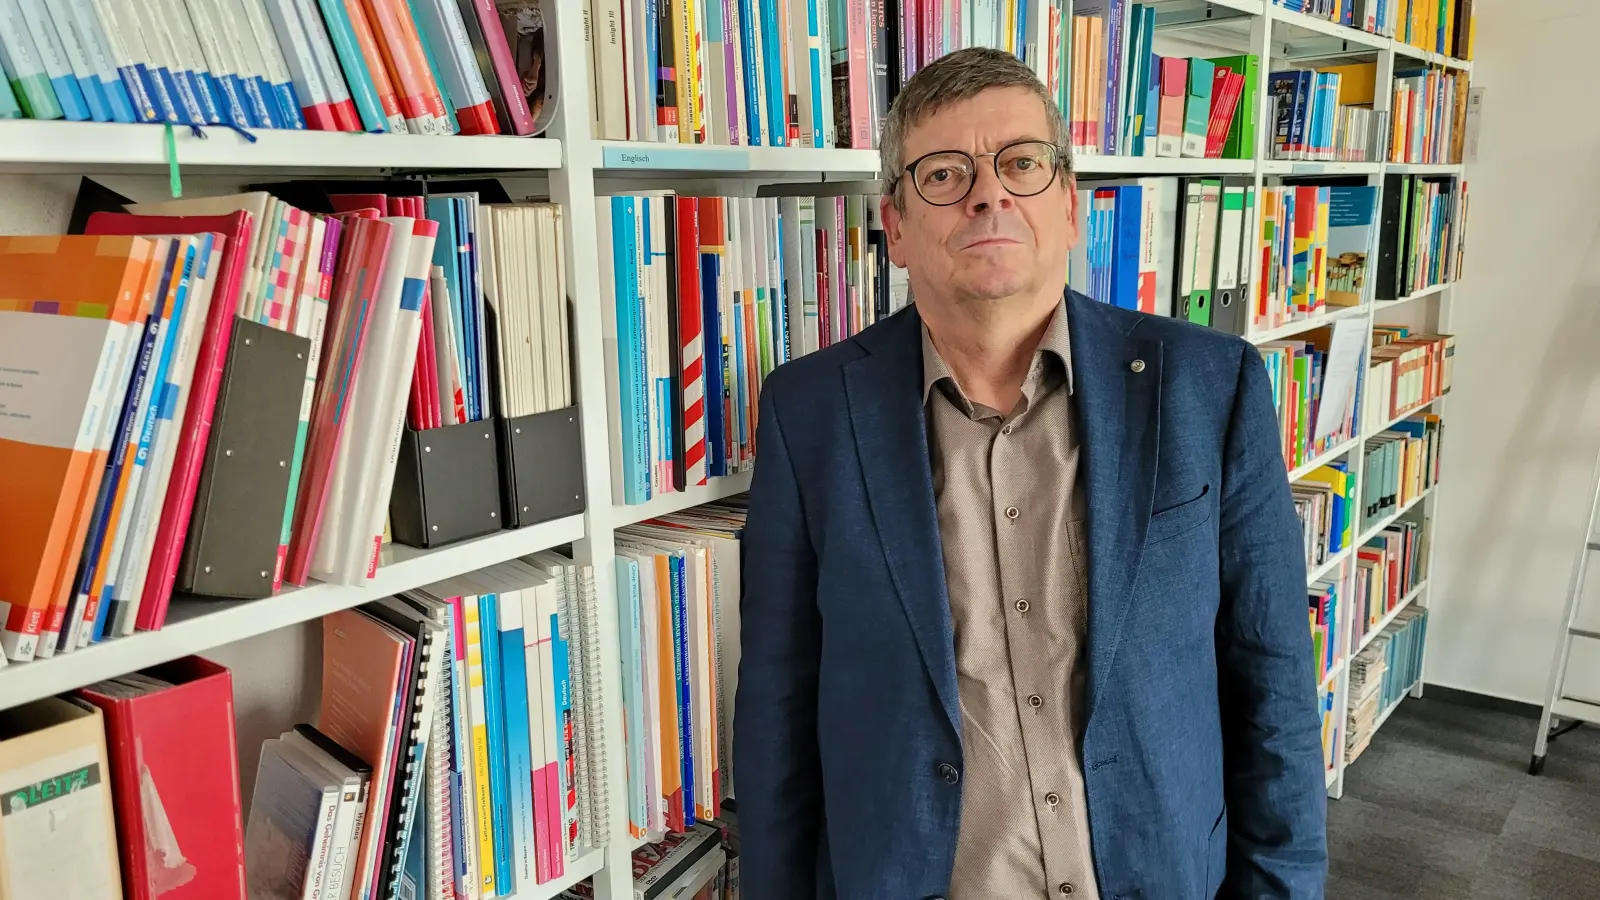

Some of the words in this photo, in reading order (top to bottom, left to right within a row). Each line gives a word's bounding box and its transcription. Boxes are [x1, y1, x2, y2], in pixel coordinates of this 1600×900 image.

[608, 20, 616, 44] Insight
[870, 8, 879, 48] Literature
[621, 153, 650, 163] Englisch
[138, 446, 148, 460] 6
[27, 611, 41, 633] Klett
[674, 638, 683, 680] WORKSHEETS
[327, 804, 336, 822] Das
[566, 817, 575, 850] TRAINING
[319, 823, 333, 869] Geheimnis
[329, 846, 345, 891] BESUCH
[646, 875, 657, 884] DVD
